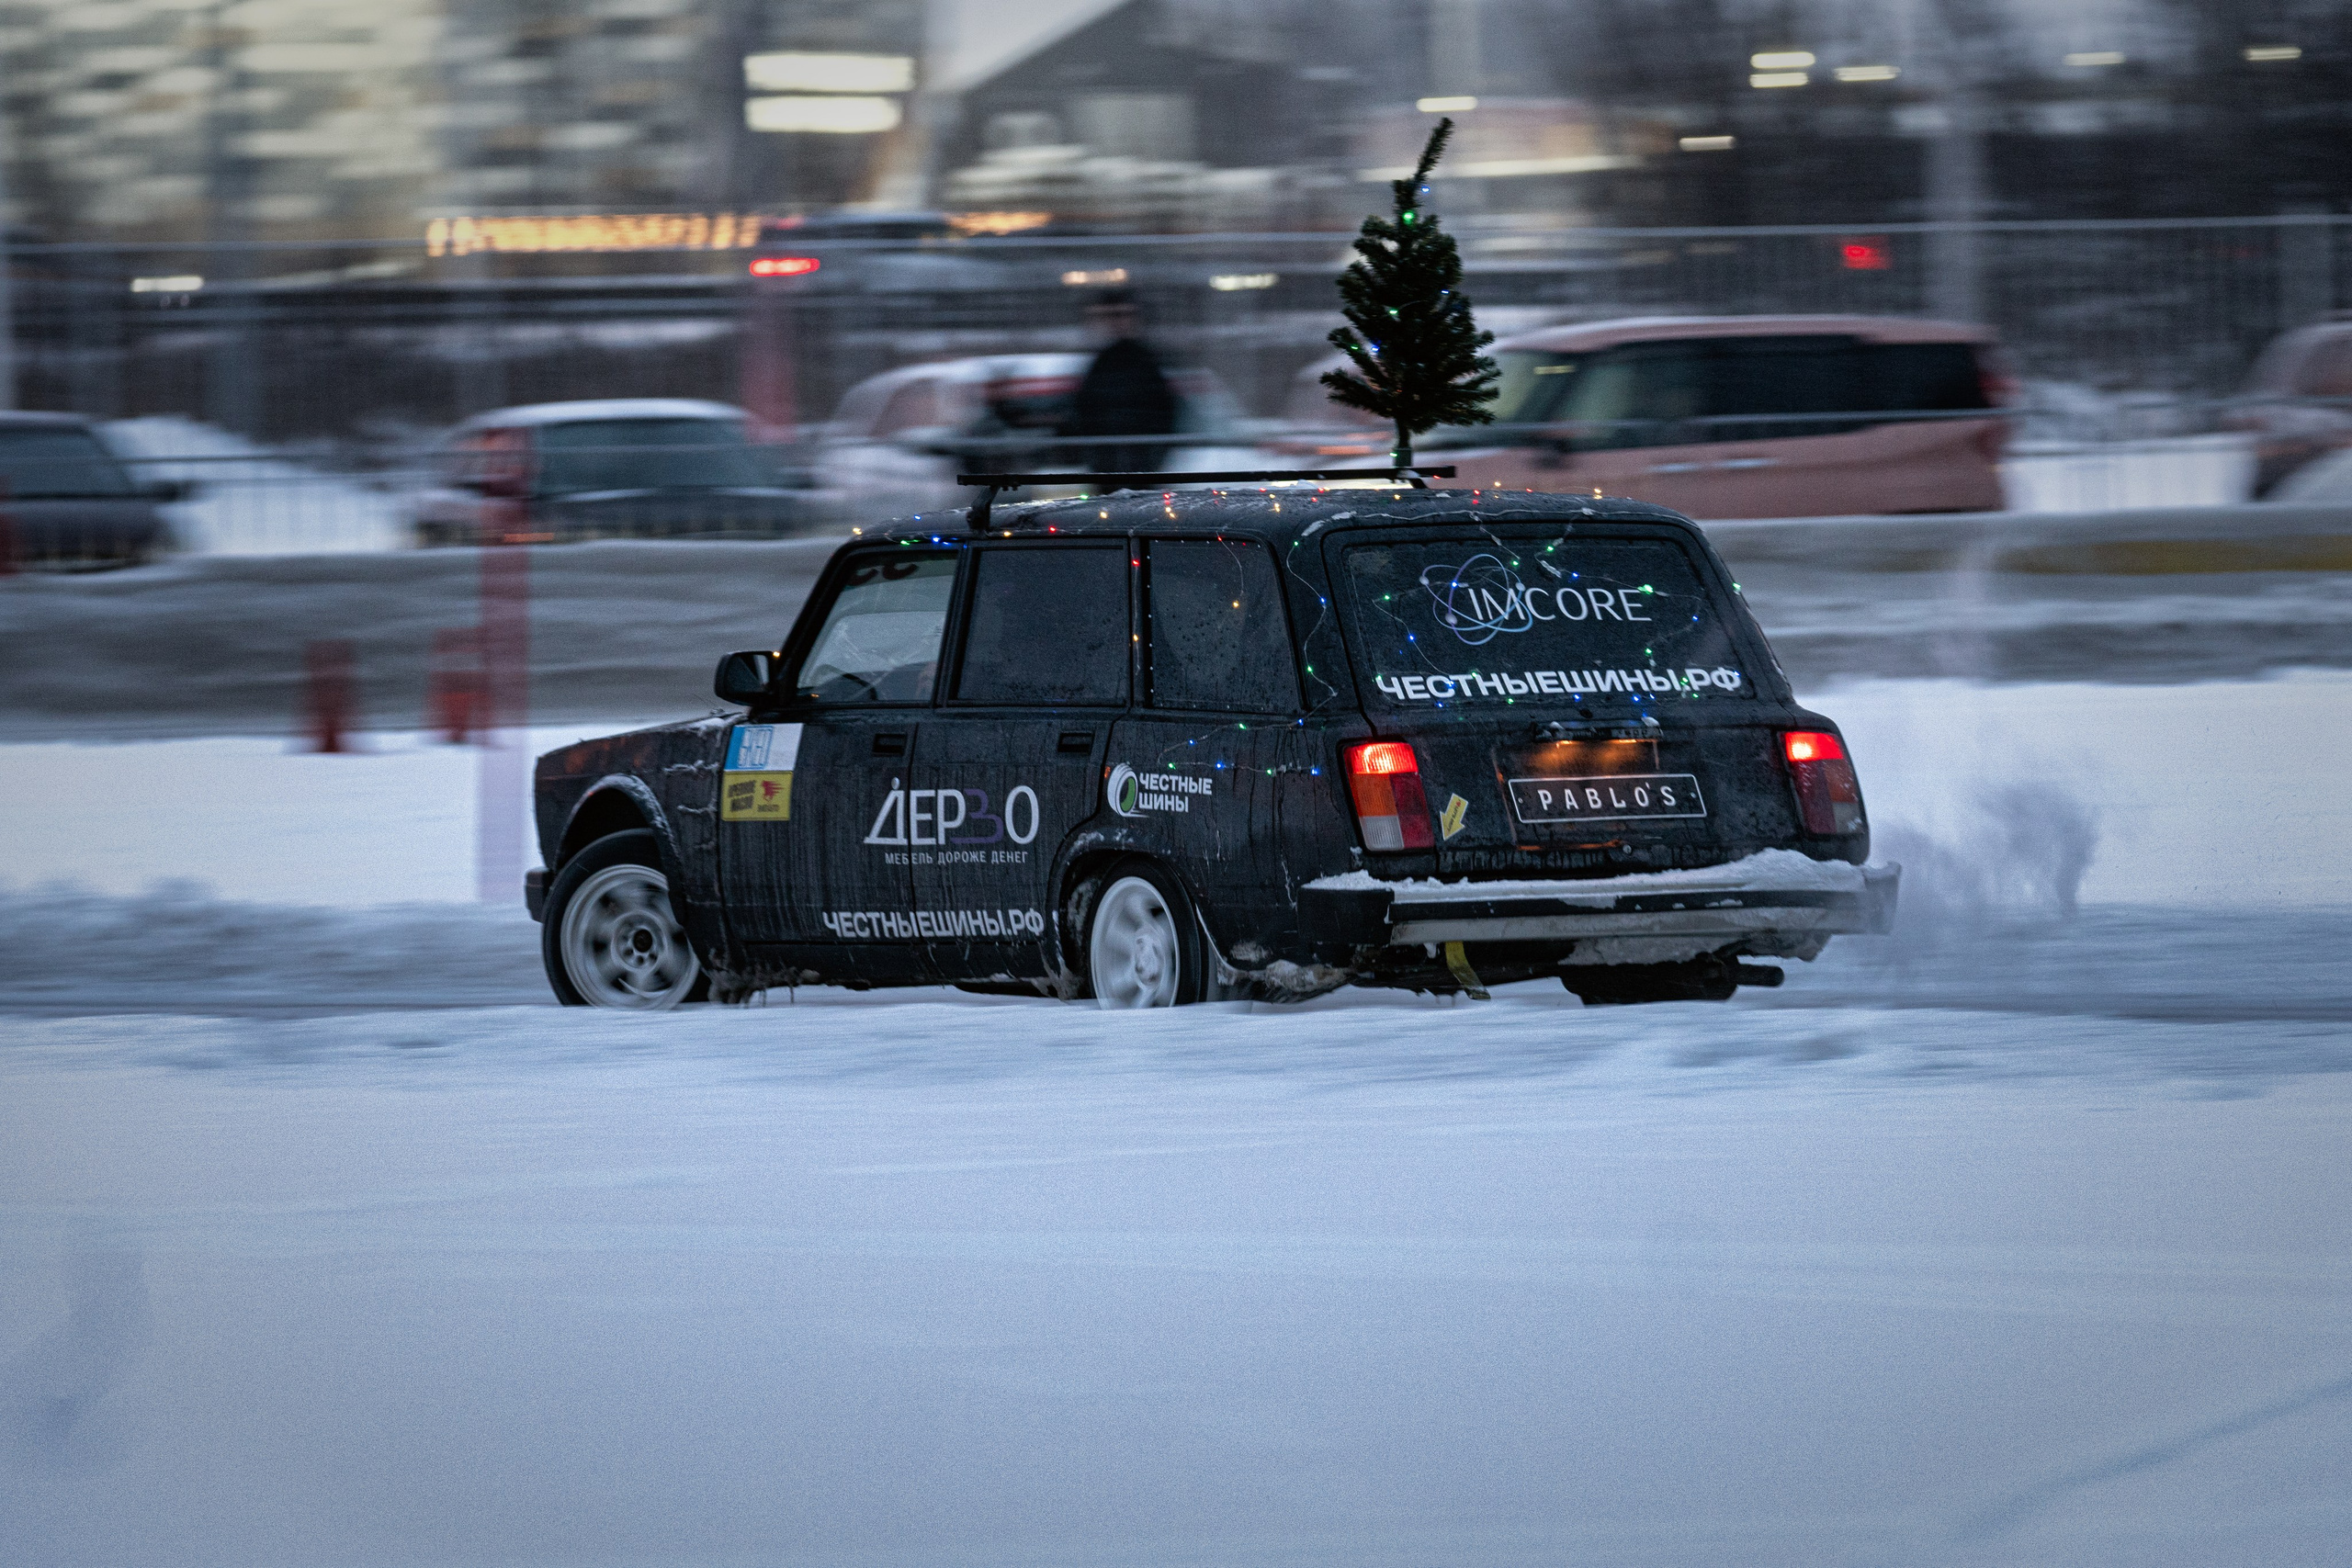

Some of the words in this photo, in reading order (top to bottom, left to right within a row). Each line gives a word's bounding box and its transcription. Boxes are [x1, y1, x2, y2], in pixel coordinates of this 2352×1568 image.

[1467, 587, 1653, 622] IMCORE
[1376, 666, 1742, 701] ЧЕСТНЫЕШИНЫ.РФ
[1138, 772, 1213, 795] ЧЕСТНЫЕ
[1537, 782, 1677, 811] PABLO'S
[864, 784, 1040, 845] ДЕРЗО
[1138, 792, 1190, 813] ШИНЫ
[884, 852, 933, 865] МЕБЕЛЬ
[937, 851, 987, 865] ДОРОЖЕ
[990, 851, 1029, 865] ДЕНЕГ
[822, 908, 1045, 939] ЧЕСТНЫЕШИНЫ.РФ
